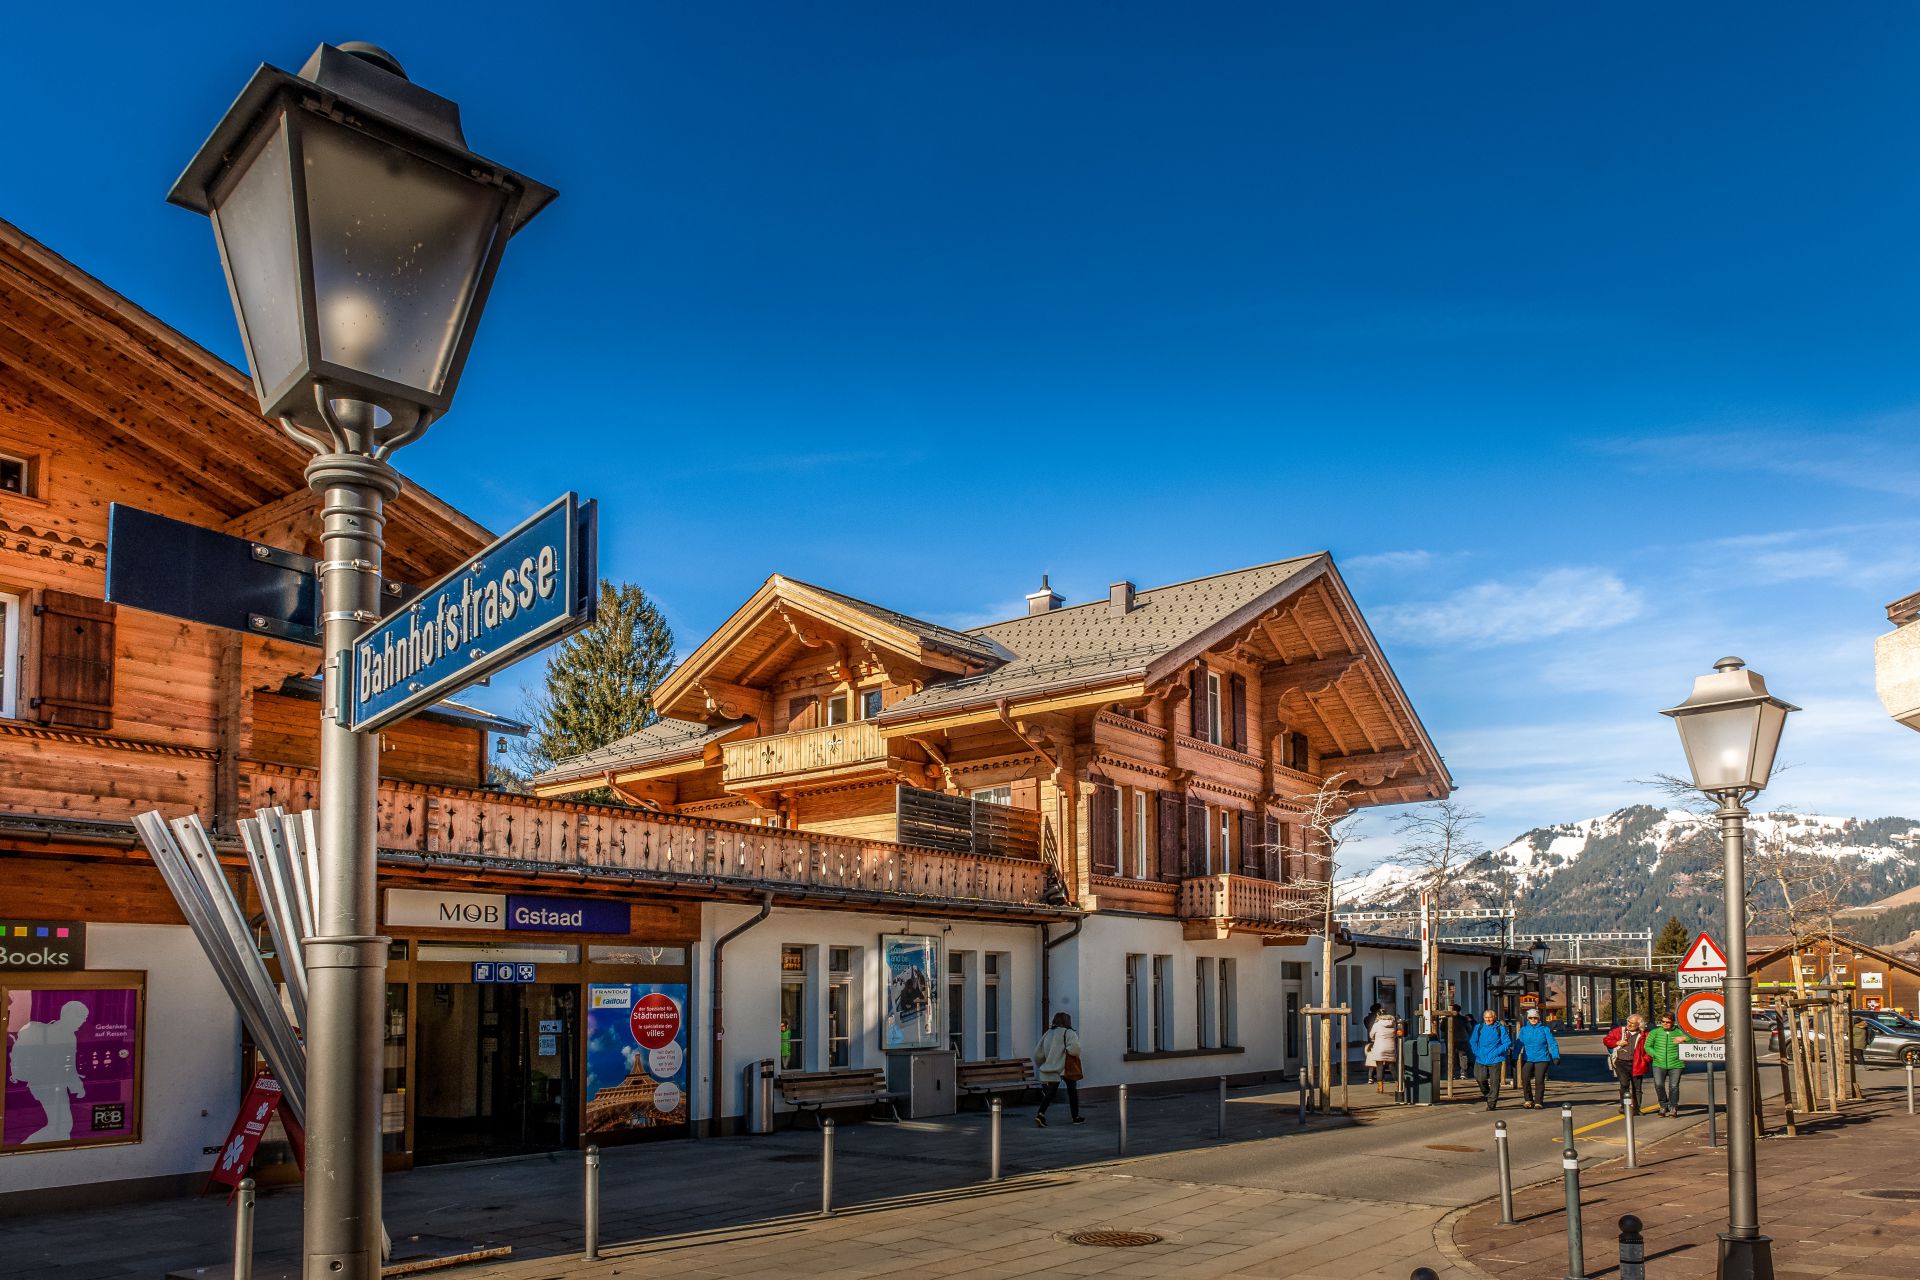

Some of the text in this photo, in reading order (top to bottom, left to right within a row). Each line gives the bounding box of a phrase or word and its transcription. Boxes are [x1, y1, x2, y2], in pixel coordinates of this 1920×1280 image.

[360, 545, 558, 704] Bahnhofstrasse
[439, 903, 499, 923] MOB
[515, 907, 583, 927] Gstaad
[0, 946, 70, 965] Books
[602, 997, 628, 1005] railtour
[633, 1011, 678, 1020] Städtereisen
[646, 1029, 665, 1037] villes
[95, 1111, 121, 1123] P&B
